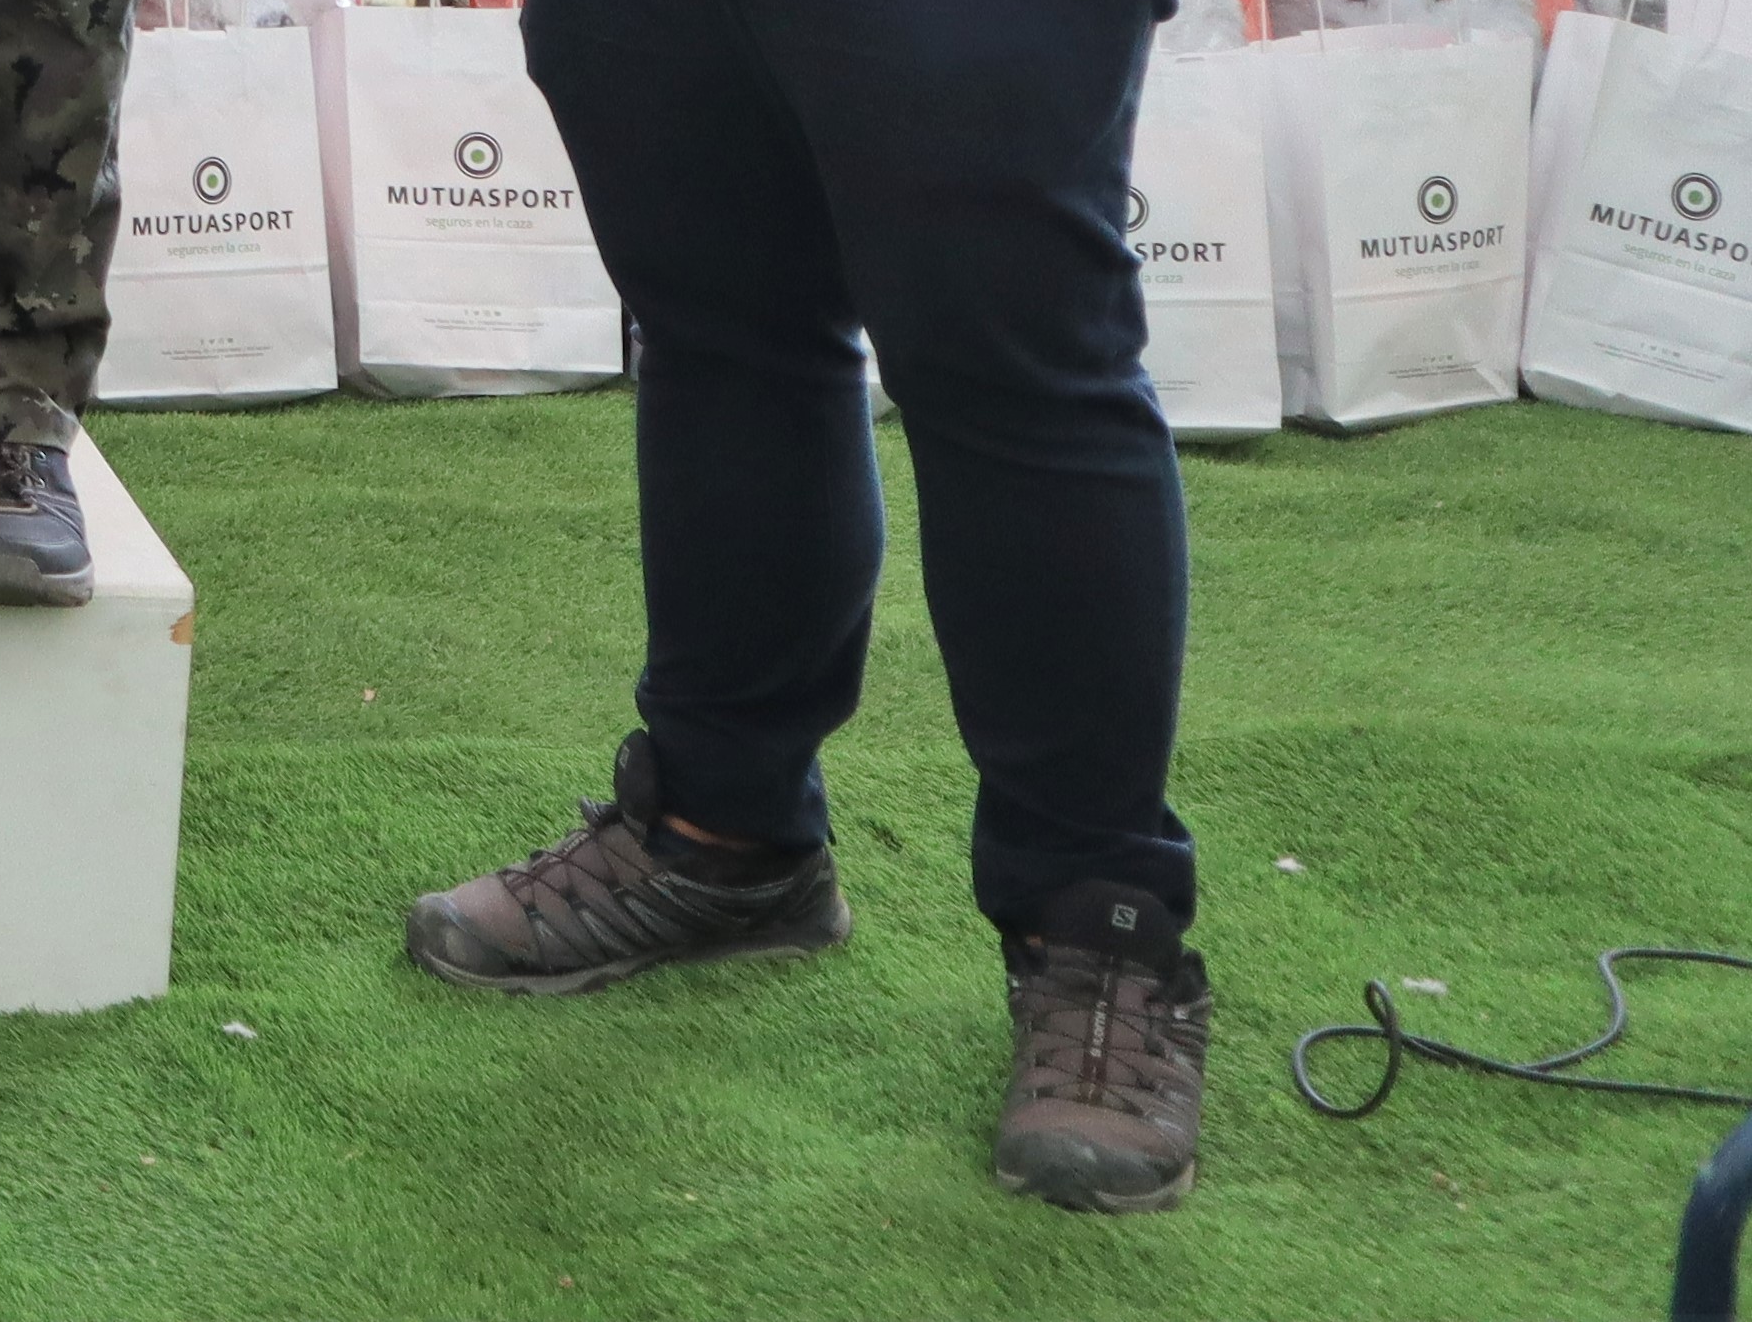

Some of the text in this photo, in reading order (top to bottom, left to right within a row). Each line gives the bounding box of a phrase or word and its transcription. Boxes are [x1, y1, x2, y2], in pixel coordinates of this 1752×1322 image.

[388, 186, 575, 209] MUTUASPORT
[133, 210, 294, 236] MUTUASPORT
[425, 217, 533, 230] seguros en la caza
[1590, 203, 1752, 264] MUTUASPO
[167, 243, 261, 259] seguros en la caza
[1134, 243, 1226, 262] SPORT
[1361, 225, 1505, 259] MUTUASPORT
[1623, 243, 1736, 282] seguros en la caza
[1156, 273, 1184, 284] caza
